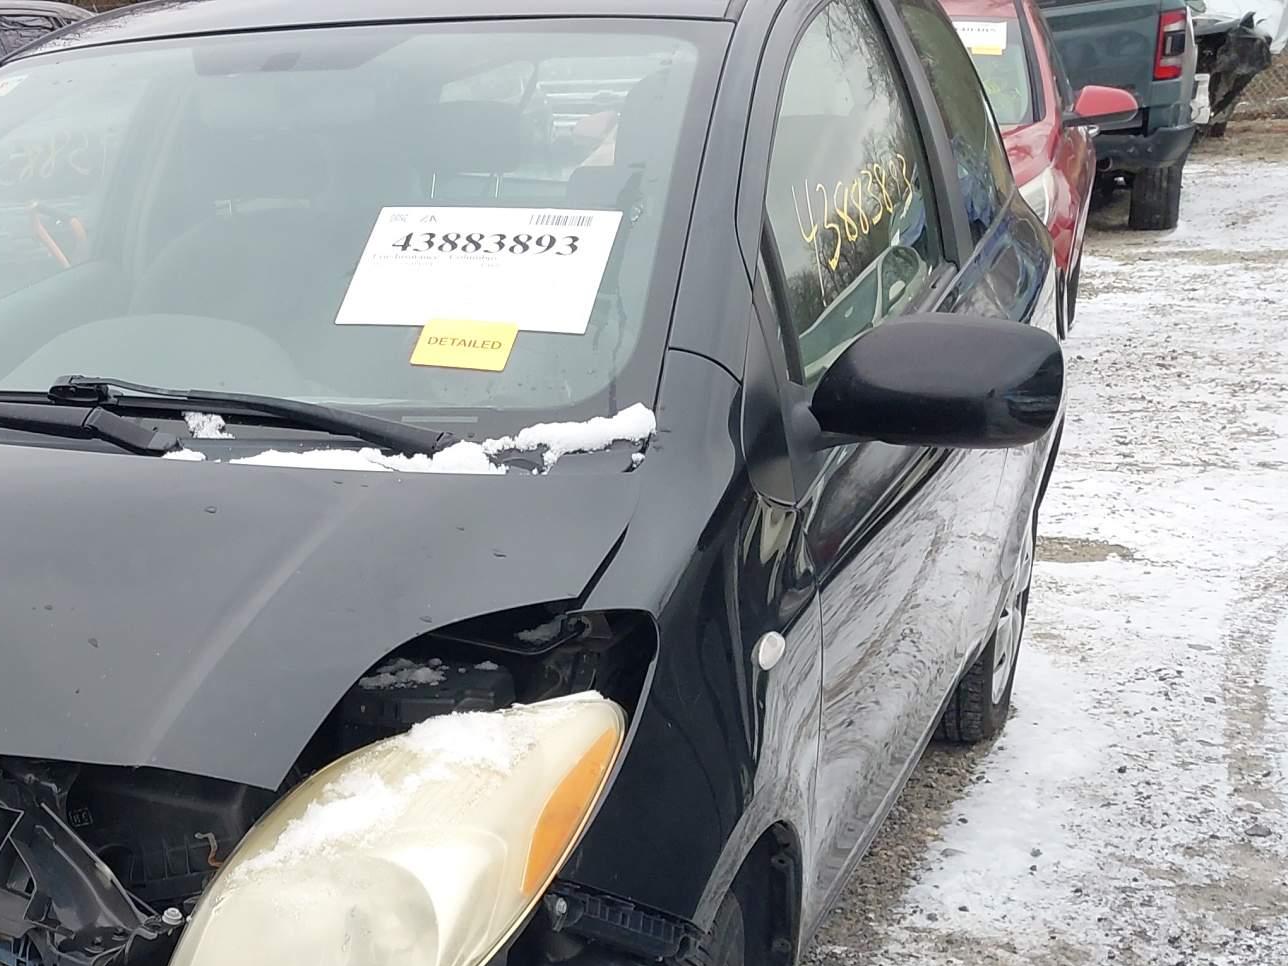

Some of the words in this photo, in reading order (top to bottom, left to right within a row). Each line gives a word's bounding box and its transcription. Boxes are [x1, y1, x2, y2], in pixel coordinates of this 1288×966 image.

[791, 153, 913, 307] 43883893
[391, 231, 580, 256] 43883893
[426, 335, 503, 351] DETAILED
